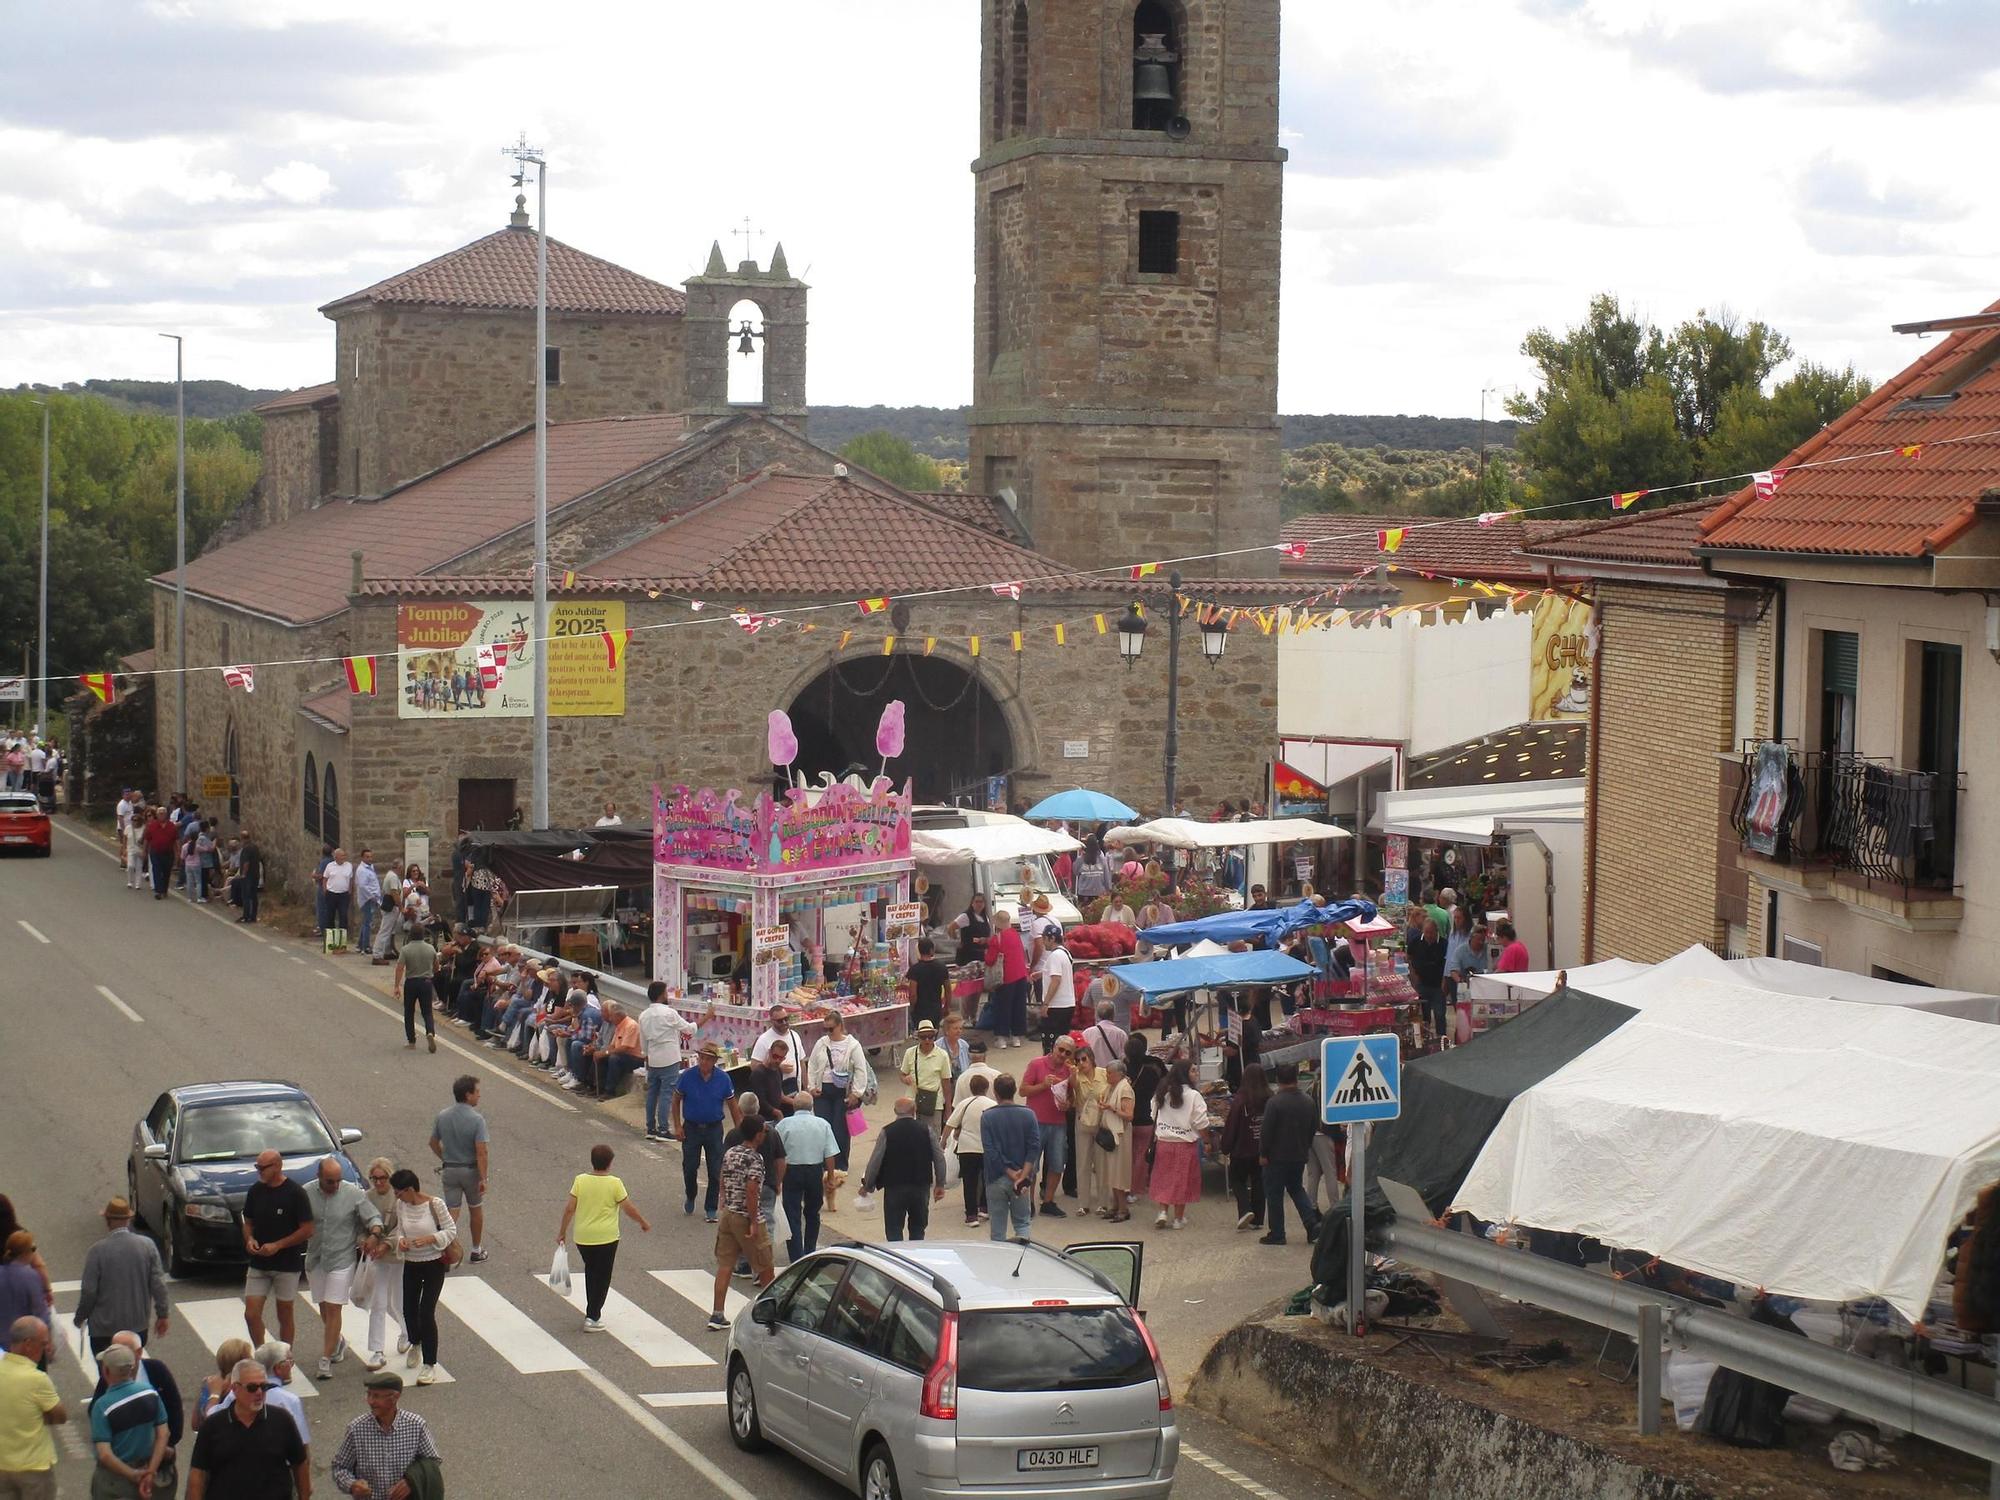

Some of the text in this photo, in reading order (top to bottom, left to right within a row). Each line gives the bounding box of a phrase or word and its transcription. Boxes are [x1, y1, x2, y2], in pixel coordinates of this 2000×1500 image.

[406, 606, 468, 625] Templo
[575, 607, 607, 616] Jubilar
[408, 627, 469, 643] Jubilar
[555, 618, 607, 636] 2025
[1029, 1449, 1094, 1465] 0430 HLF
